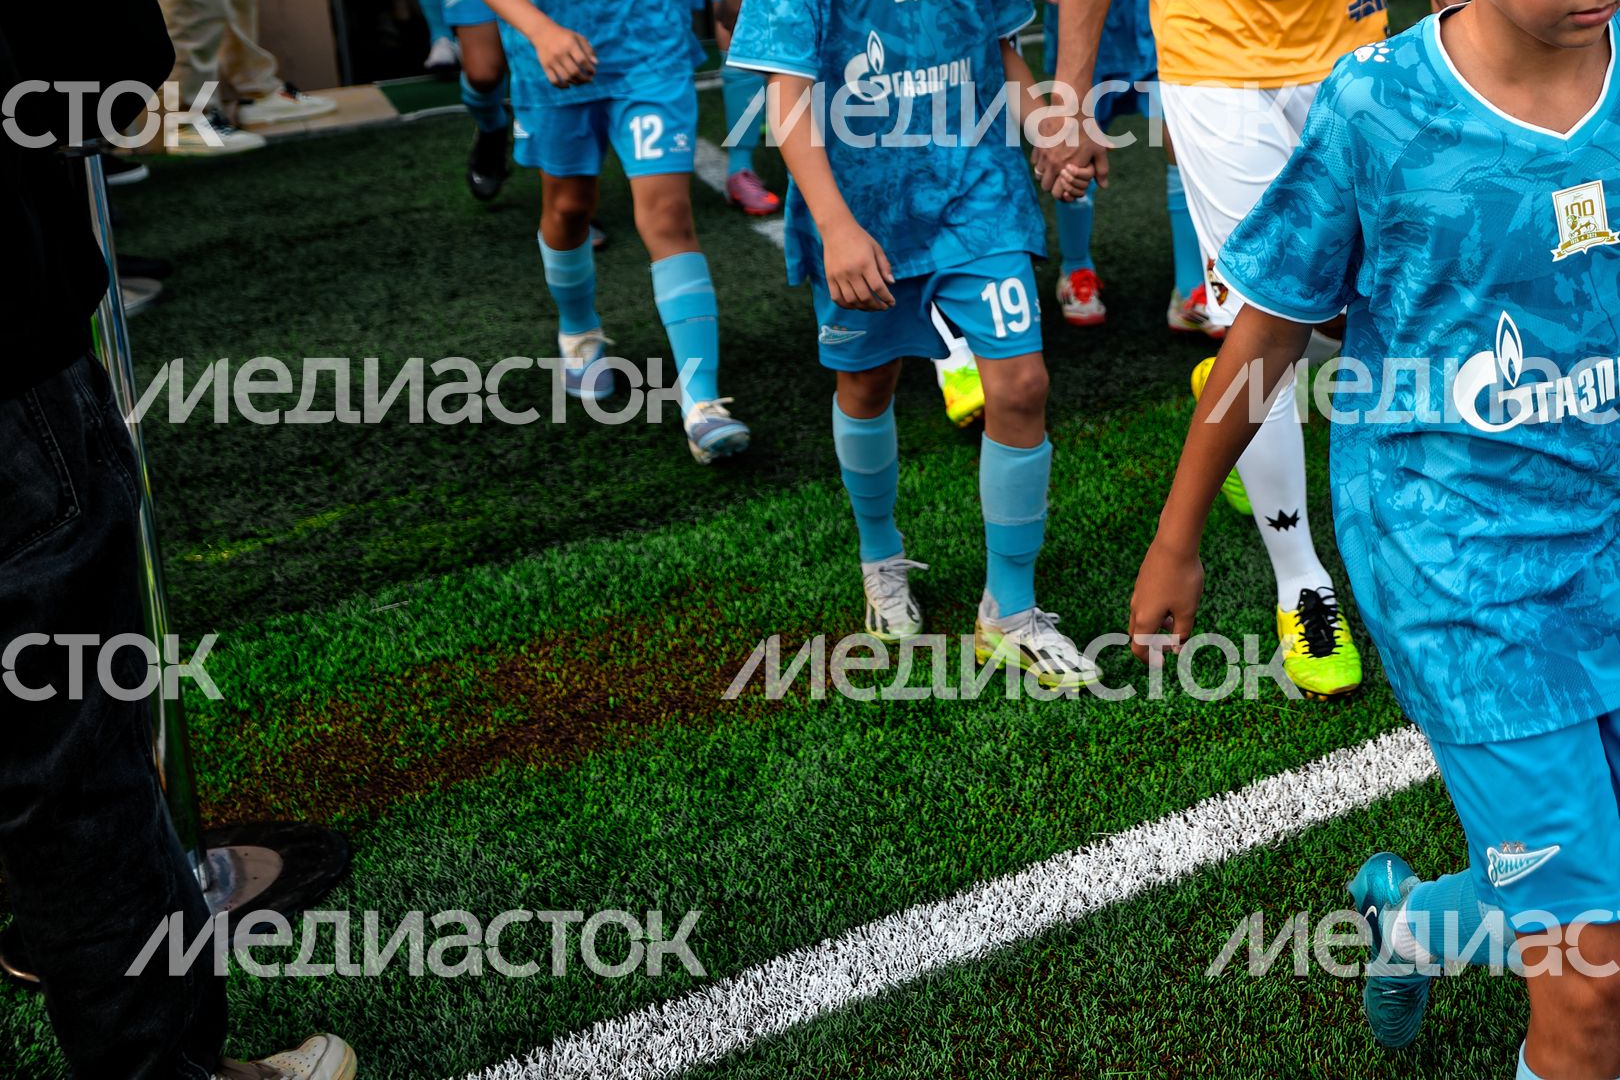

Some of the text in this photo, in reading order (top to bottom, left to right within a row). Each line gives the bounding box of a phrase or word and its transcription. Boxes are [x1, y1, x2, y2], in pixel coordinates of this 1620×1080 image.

[892, 57, 972, 98] ГАЗПРОМ
[629, 114, 664, 161] 12
[1564, 199, 1595, 217] 100
[981, 277, 1031, 338] 19
